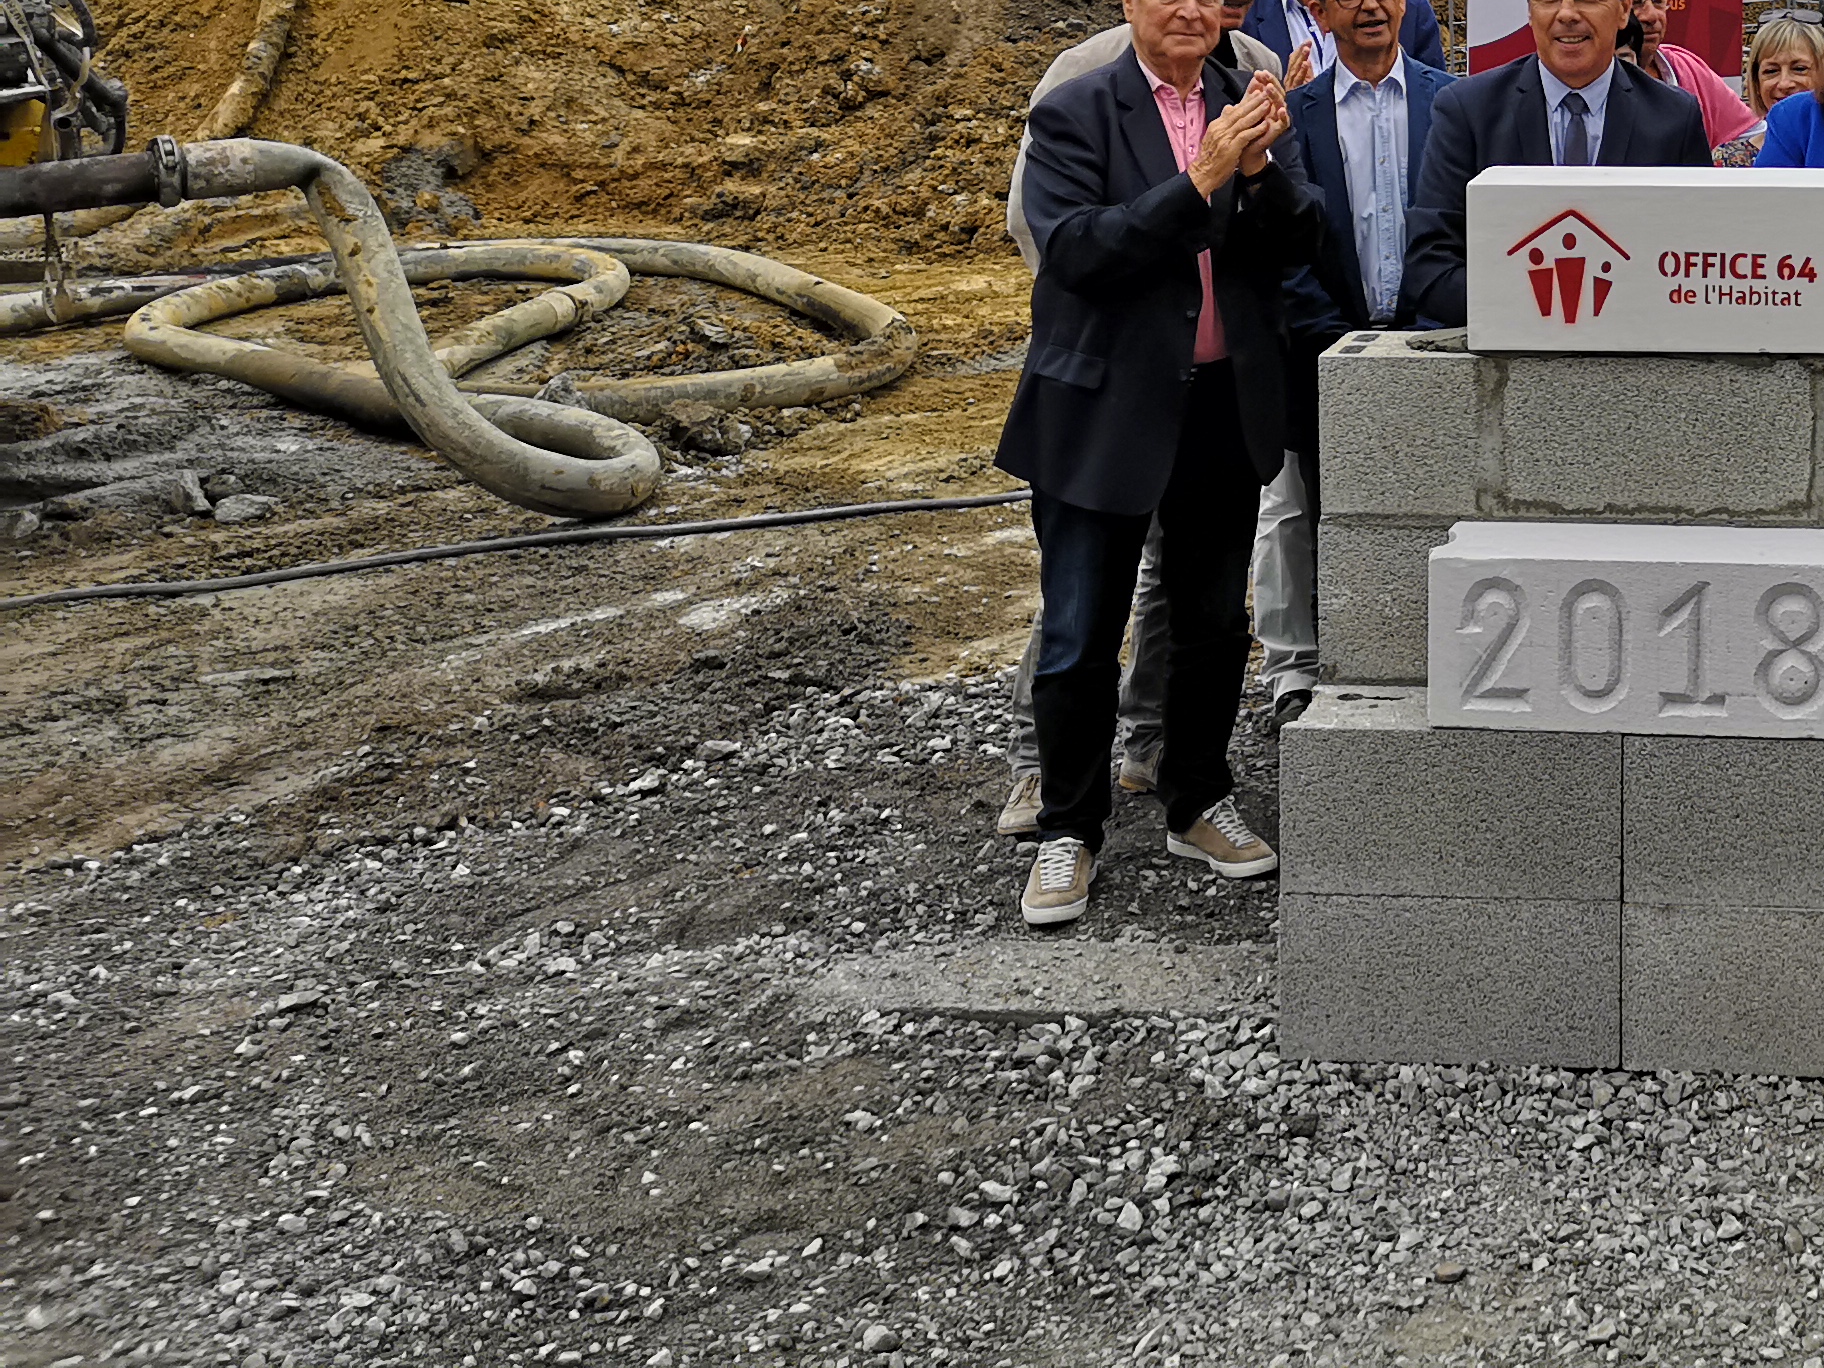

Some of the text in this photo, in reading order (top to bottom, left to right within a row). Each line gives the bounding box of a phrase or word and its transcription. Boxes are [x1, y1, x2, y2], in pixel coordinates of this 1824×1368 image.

[1668, 0, 1687, 10] us
[1658, 251, 1818, 283] OFFICE 64
[1669, 283, 1802, 306] de l'Habitat
